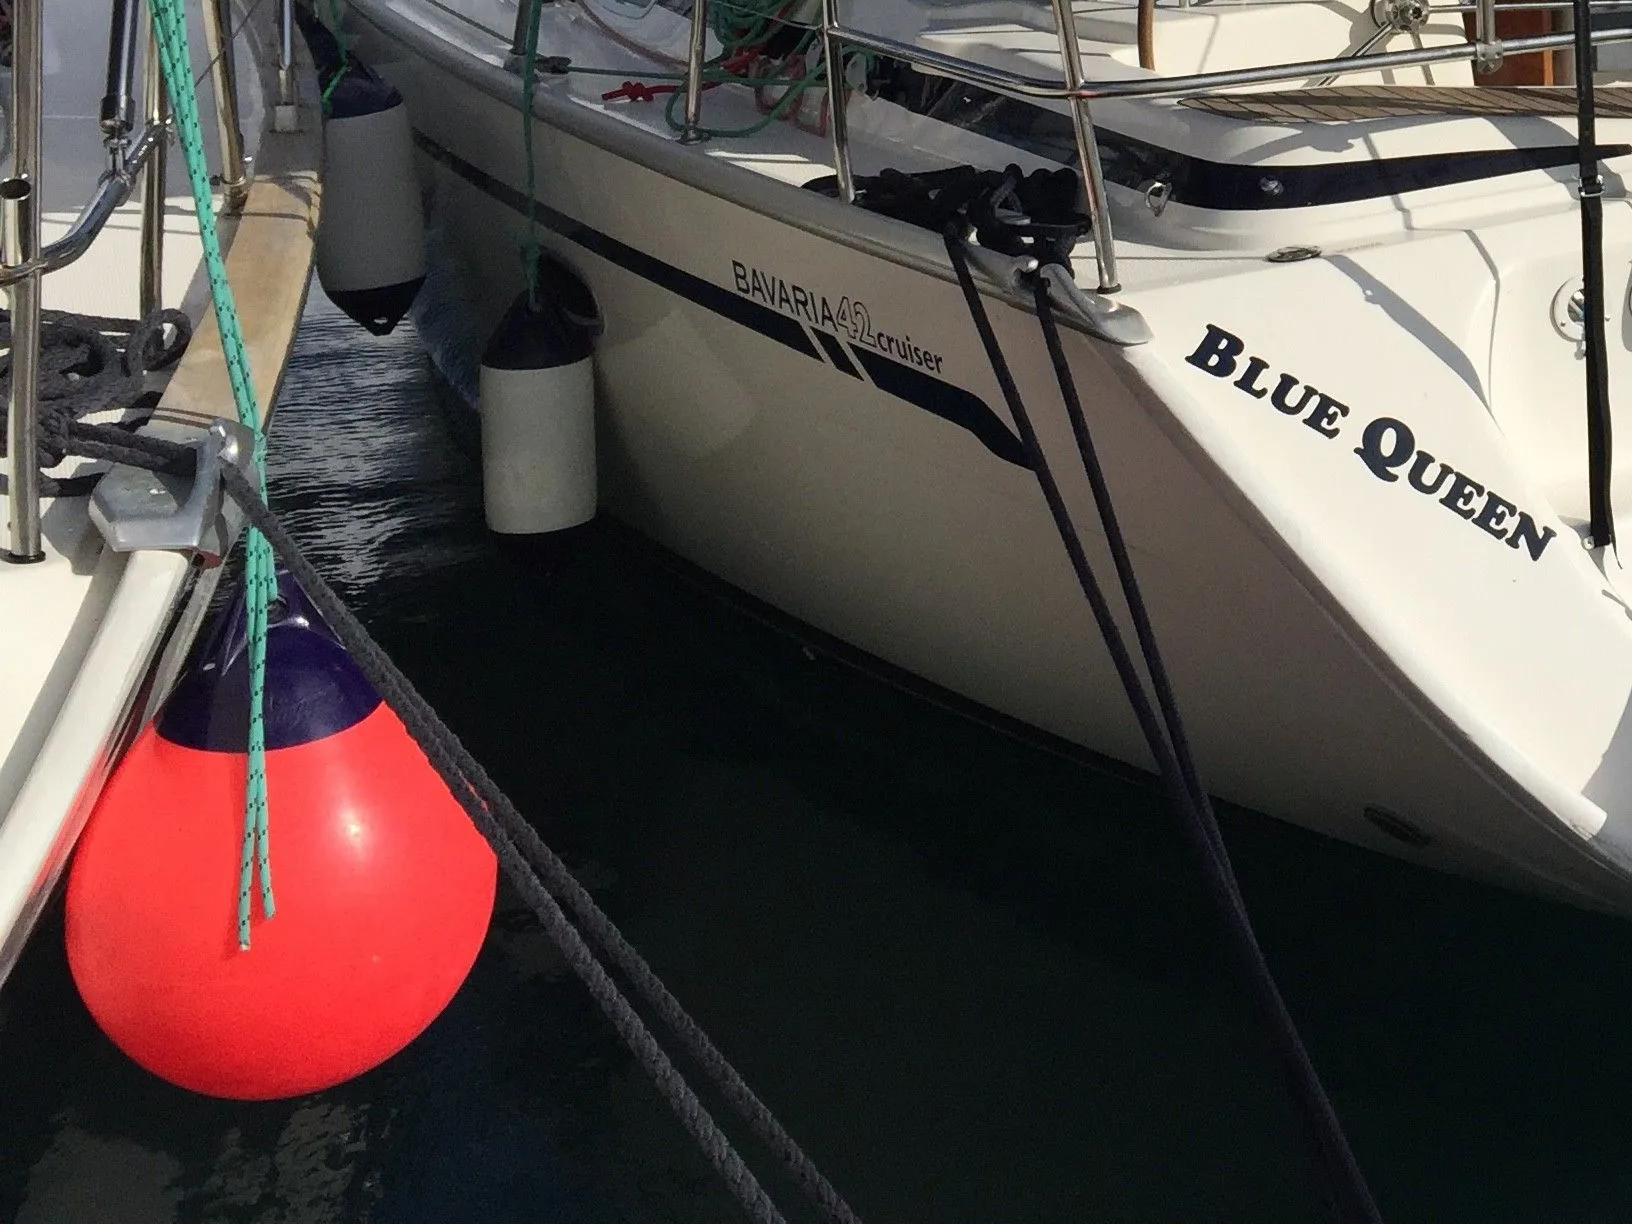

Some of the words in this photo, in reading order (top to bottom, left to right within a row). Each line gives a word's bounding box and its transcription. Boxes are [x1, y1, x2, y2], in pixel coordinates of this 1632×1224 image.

[732, 259, 839, 333] BAVARIA
[835, 295, 877, 349] 42
[876, 331, 943, 375] cruiser
[1184, 323, 1351, 440] BLUE
[1353, 416, 1558, 563] QUEEN
